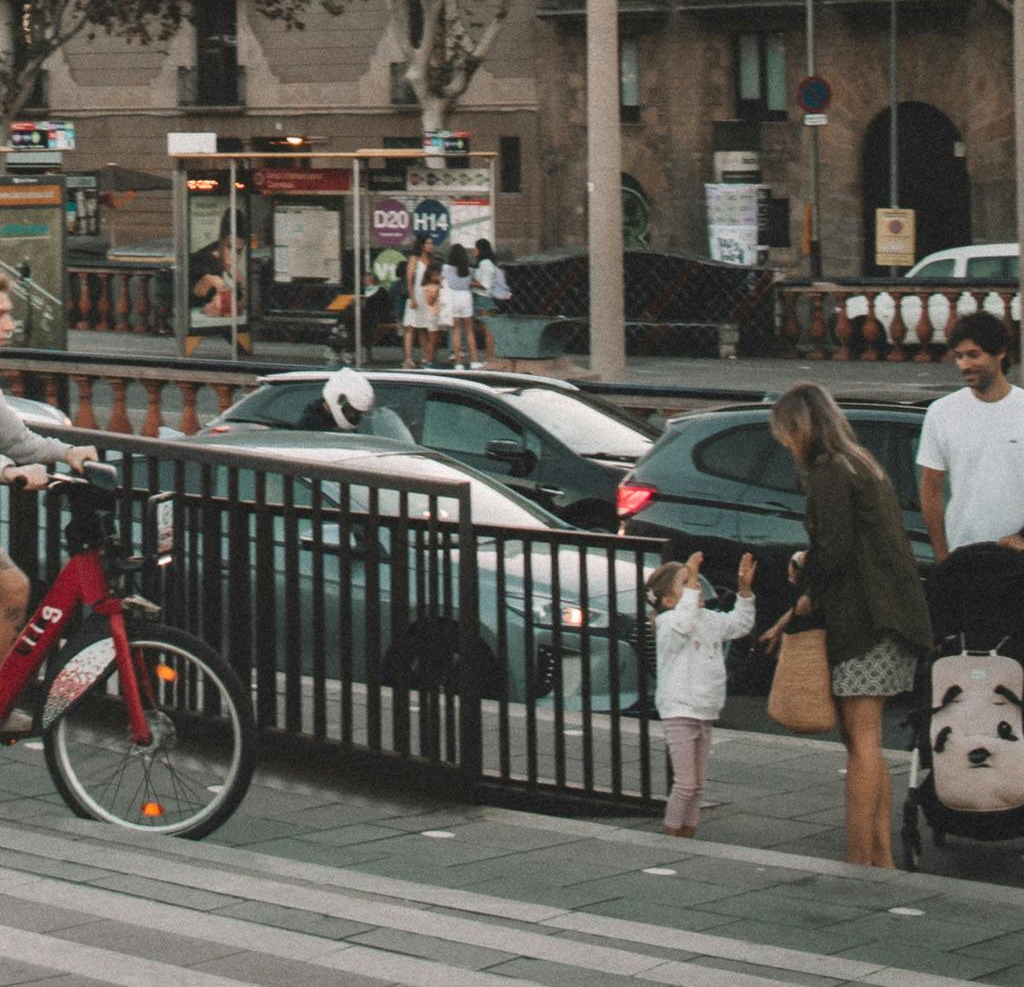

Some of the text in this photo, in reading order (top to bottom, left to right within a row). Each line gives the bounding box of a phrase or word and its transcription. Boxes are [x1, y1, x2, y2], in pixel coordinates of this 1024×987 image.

[373, 210, 410, 229] D20
[413, 212, 449, 231] H14
[373, 262, 397, 281] V1
